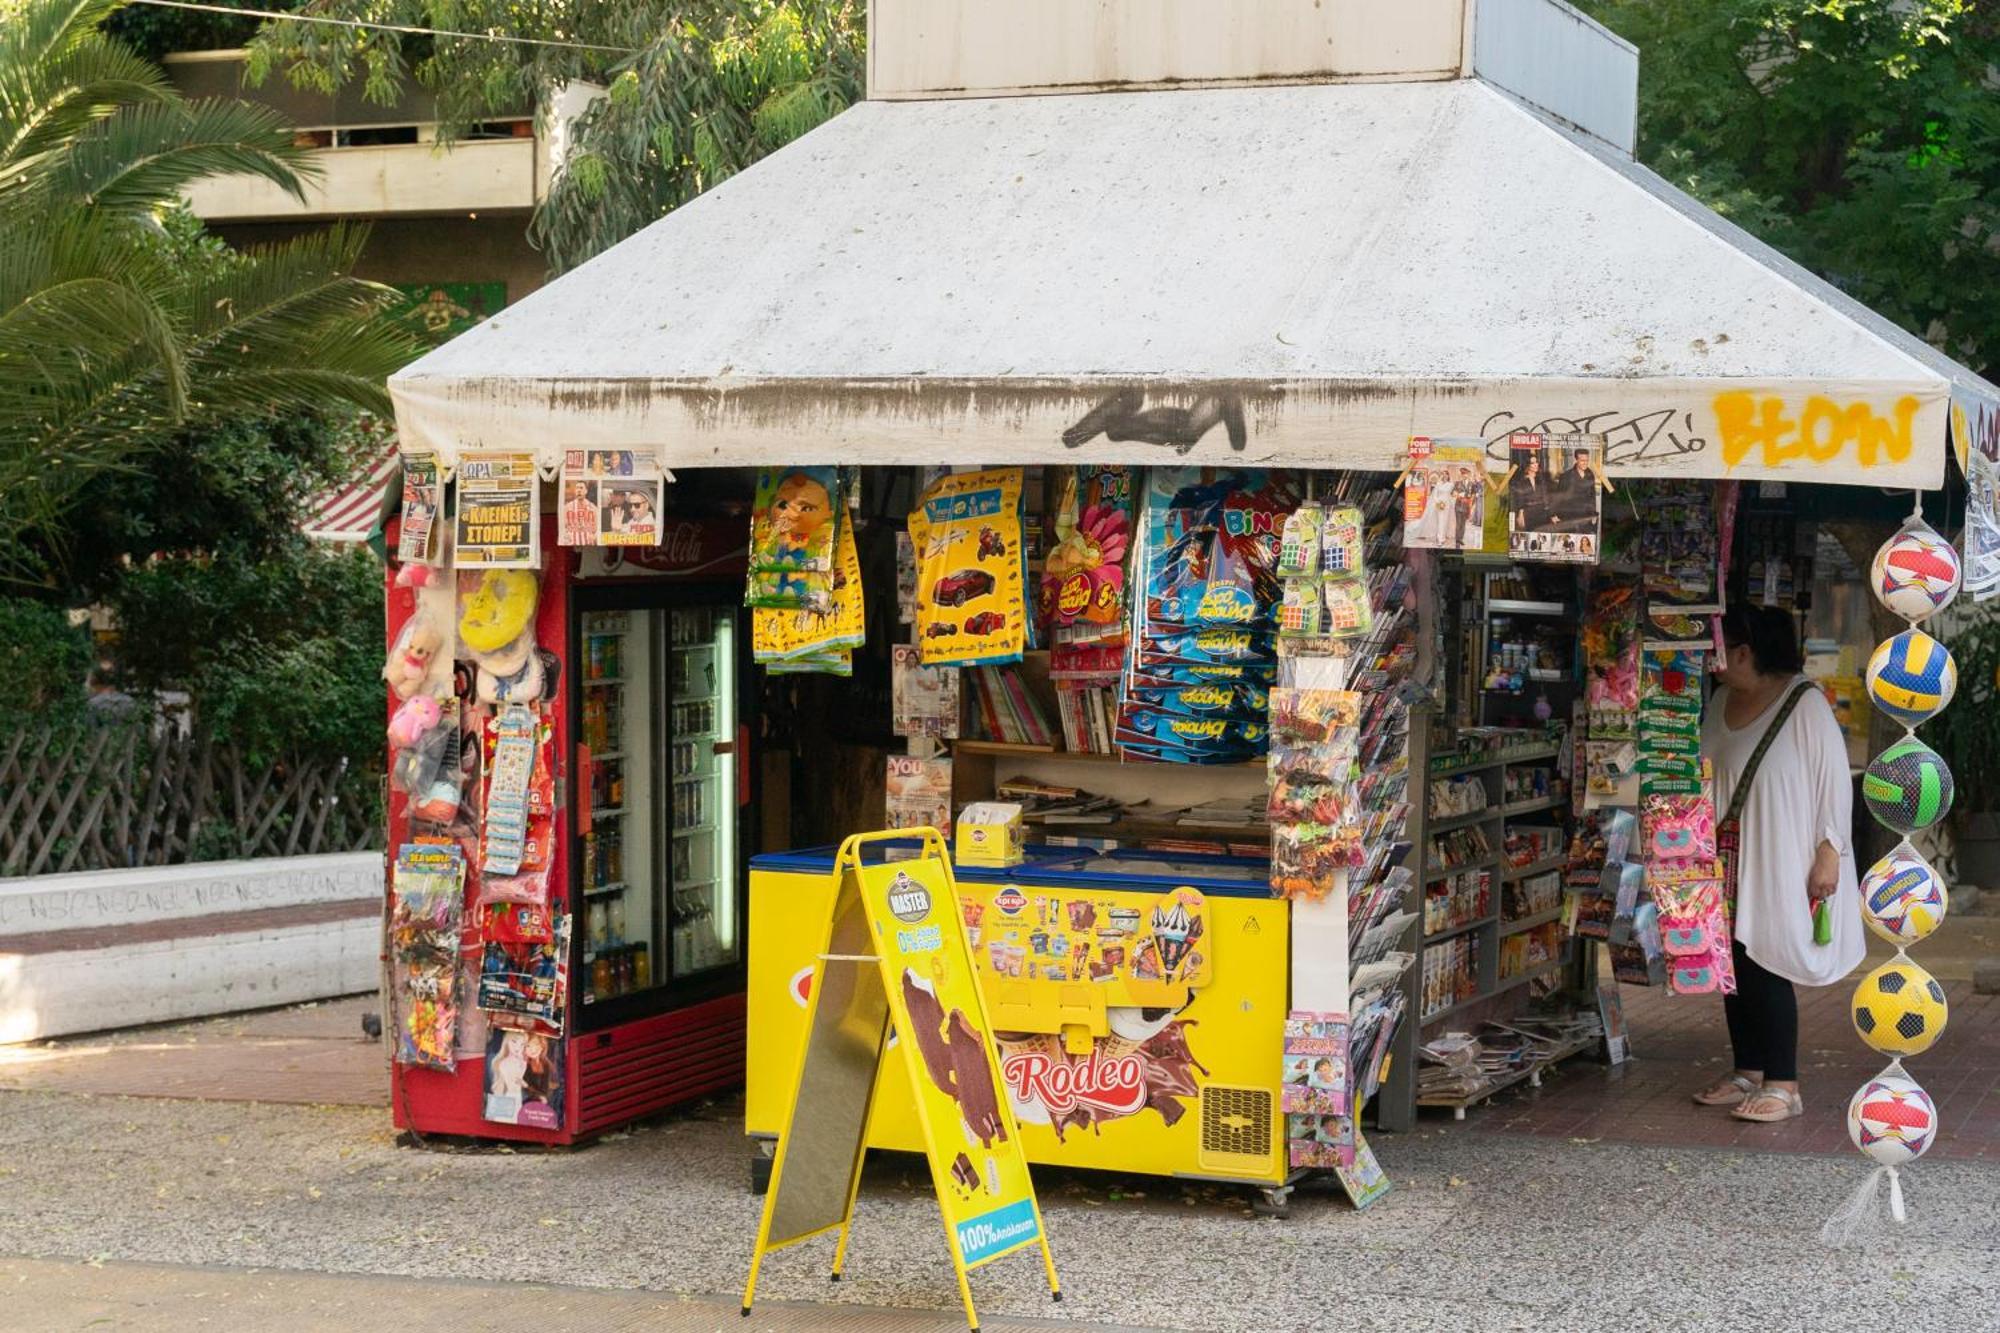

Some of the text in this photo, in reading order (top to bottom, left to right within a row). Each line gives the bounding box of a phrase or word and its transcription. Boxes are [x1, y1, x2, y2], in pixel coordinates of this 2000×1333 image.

[890, 891, 928, 914] MASTER
[1003, 1047, 1147, 1115] Rodeo
[960, 1222, 996, 1254] 100%
